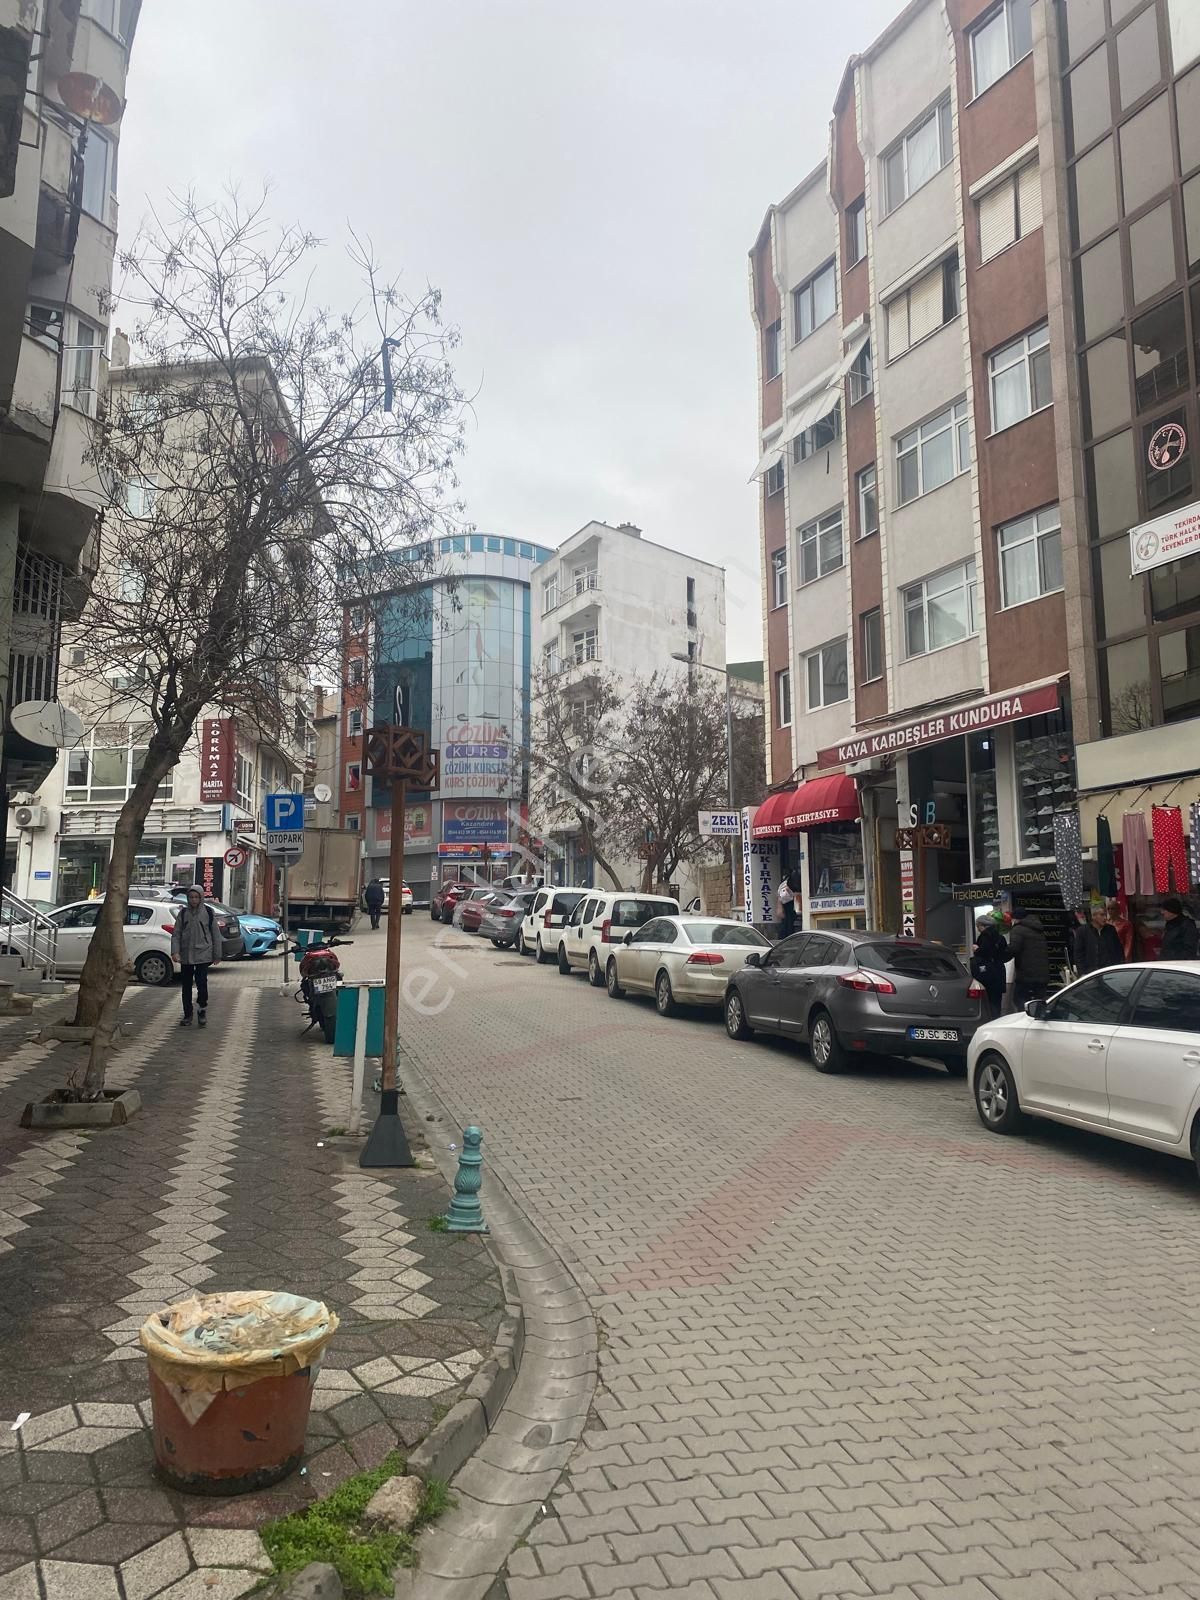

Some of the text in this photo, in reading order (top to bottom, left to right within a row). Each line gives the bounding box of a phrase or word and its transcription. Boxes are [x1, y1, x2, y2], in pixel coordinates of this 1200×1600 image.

[1161, 532, 1178, 543] TÜRK
[1179, 526, 1197, 536] HALK
[1161, 537, 1193, 552] SEVENLER
[838, 697, 1023, 761] KAYA KARDEŞLER KUNDURA
[208, 721, 220, 777] KORKMAZ
[453, 746, 500, 757] KURS
[444, 776, 465, 788] KURS
[274, 798, 296, 828] P
[712, 813, 738, 826] ZEKİ
[796, 808, 839, 824] KIRTASİYE
[268, 833, 303, 844] OTOPARK
[751, 843, 778, 855] ZEKİ
[743, 818, 753, 922] KIRTASİYE
[954, 887, 994, 901] TEKİRDAĞ
[914, 1029, 957, 1040] 59 SC 363
